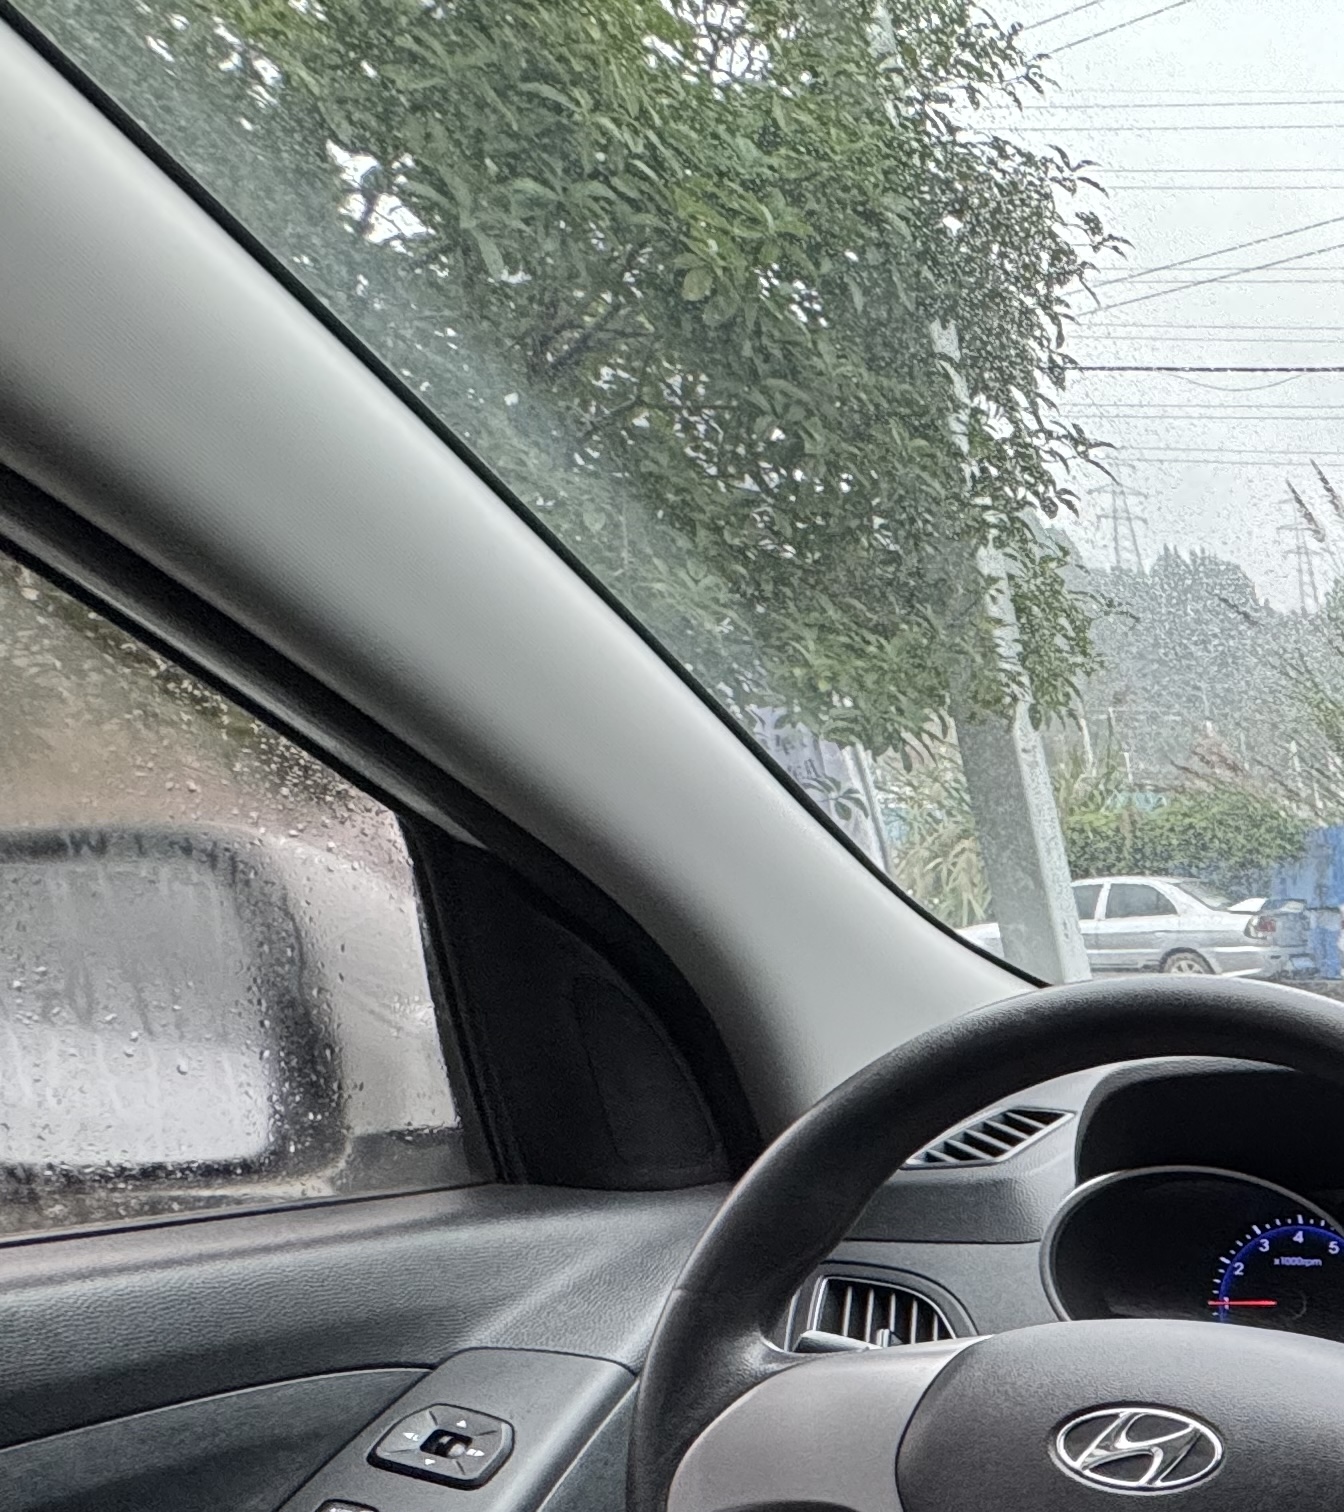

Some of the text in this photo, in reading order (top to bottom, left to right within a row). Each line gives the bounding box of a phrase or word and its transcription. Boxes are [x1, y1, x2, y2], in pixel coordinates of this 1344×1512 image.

[1293, 1231, 1304, 1243] 4
[1259, 1239, 1270, 1252] 3
[1328, 1241, 1340, 1254] 5
[1233, 1262, 1245, 1276] 2
